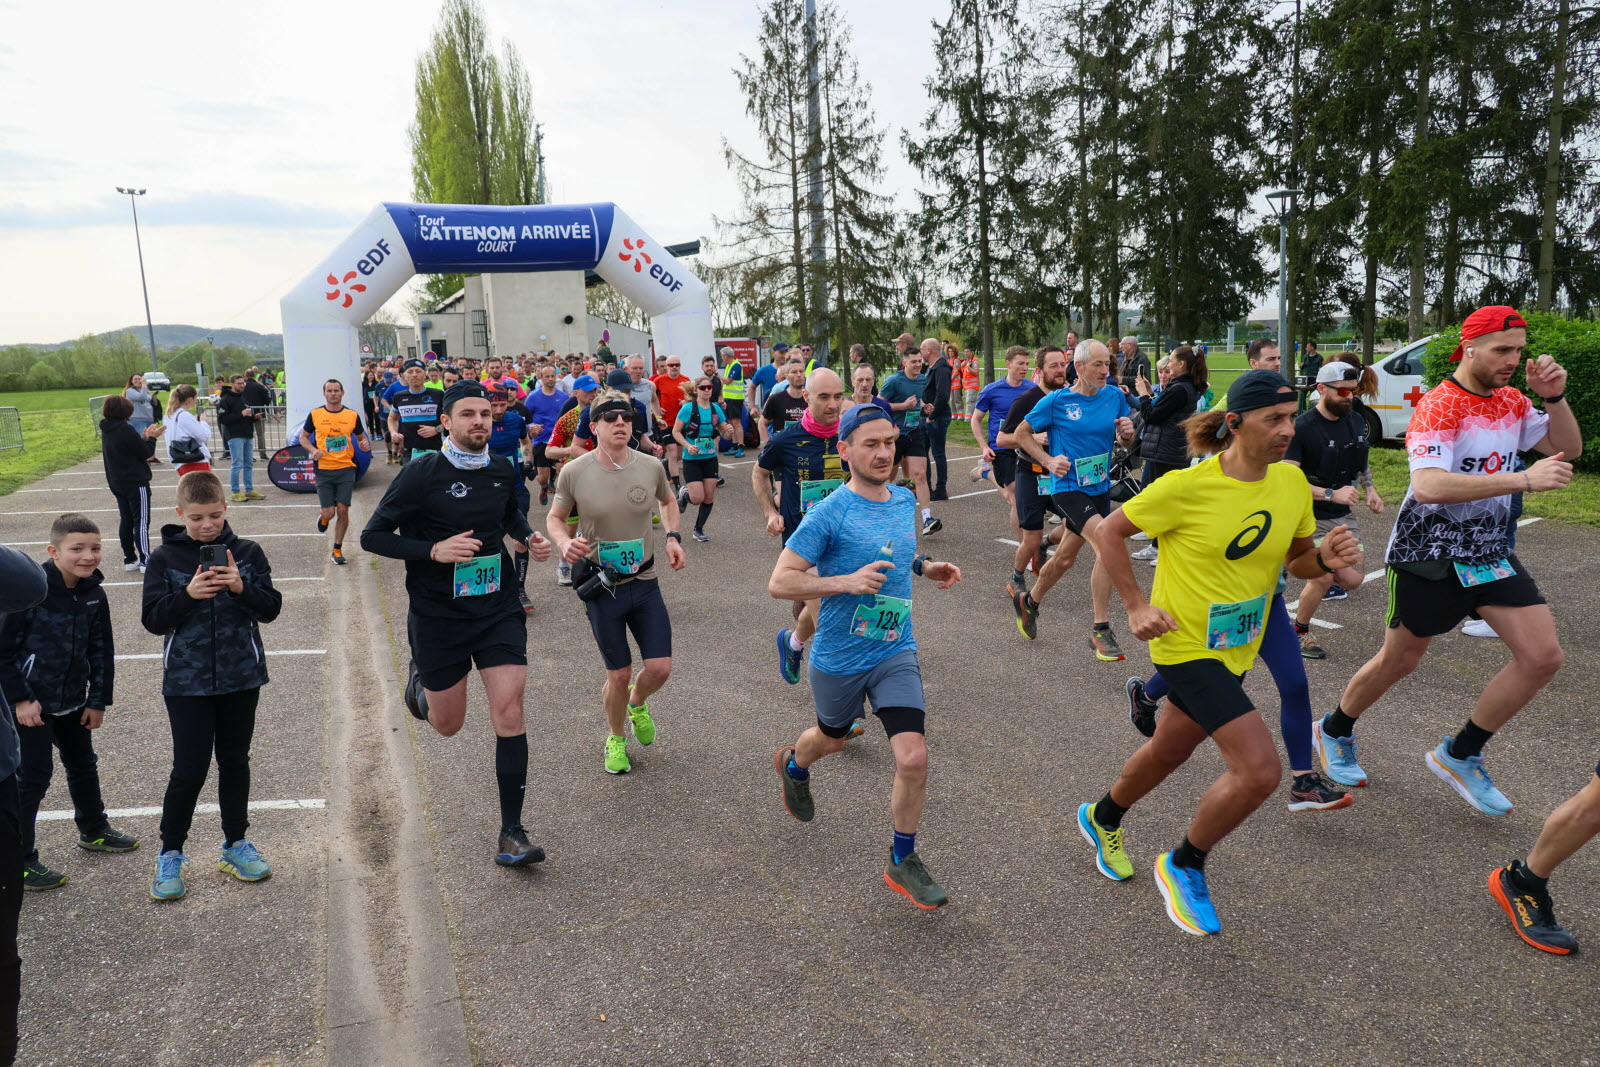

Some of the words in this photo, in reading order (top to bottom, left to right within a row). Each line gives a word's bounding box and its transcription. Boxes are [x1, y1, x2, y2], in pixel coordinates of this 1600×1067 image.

[418, 215, 445, 226] Tout
[420, 226, 516, 241] CATTENOM
[521, 222, 591, 239] ARRIVÉE
[477, 240, 517, 253] COURT
[1093, 462, 1105, 477] 35
[1460, 452, 1513, 474] STOP!
[620, 551, 635, 567] 33
[475, 566, 495, 586] 313
[876, 609, 900, 631] 128
[1236, 610, 1258, 635] 311
[1513, 897, 1535, 928] HOKA
